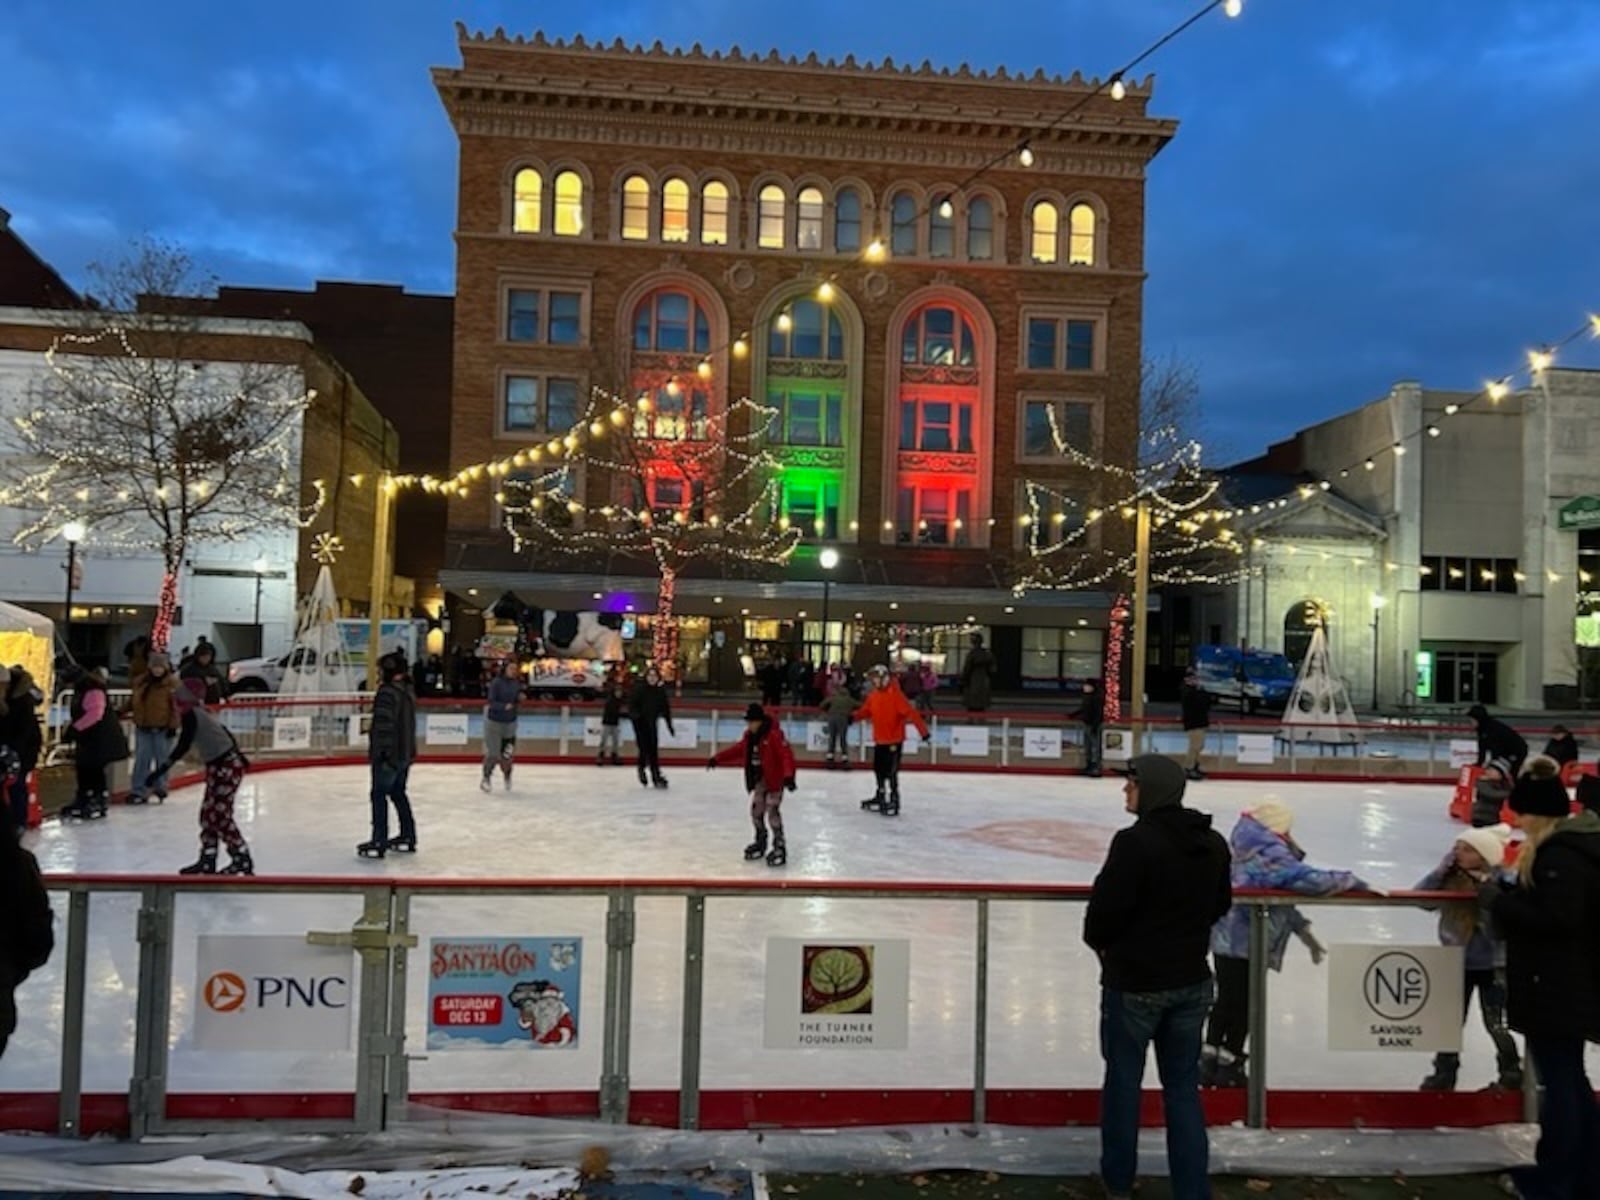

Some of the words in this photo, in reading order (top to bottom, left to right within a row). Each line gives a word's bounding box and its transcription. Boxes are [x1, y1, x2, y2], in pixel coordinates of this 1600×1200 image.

[253, 977, 347, 1009] PNC
[439, 997, 497, 1012] SATURDAY
[449, 1011, 472, 1025] DEC
[473, 1011, 487, 1025] 13
[799, 1023, 822, 1033] THE
[827, 1023, 874, 1033] TURNER
[1370, 1025, 1423, 1036] SAVINGS
[799, 1034, 874, 1044] FOUNDATION
[1378, 1037, 1414, 1047] BANK
